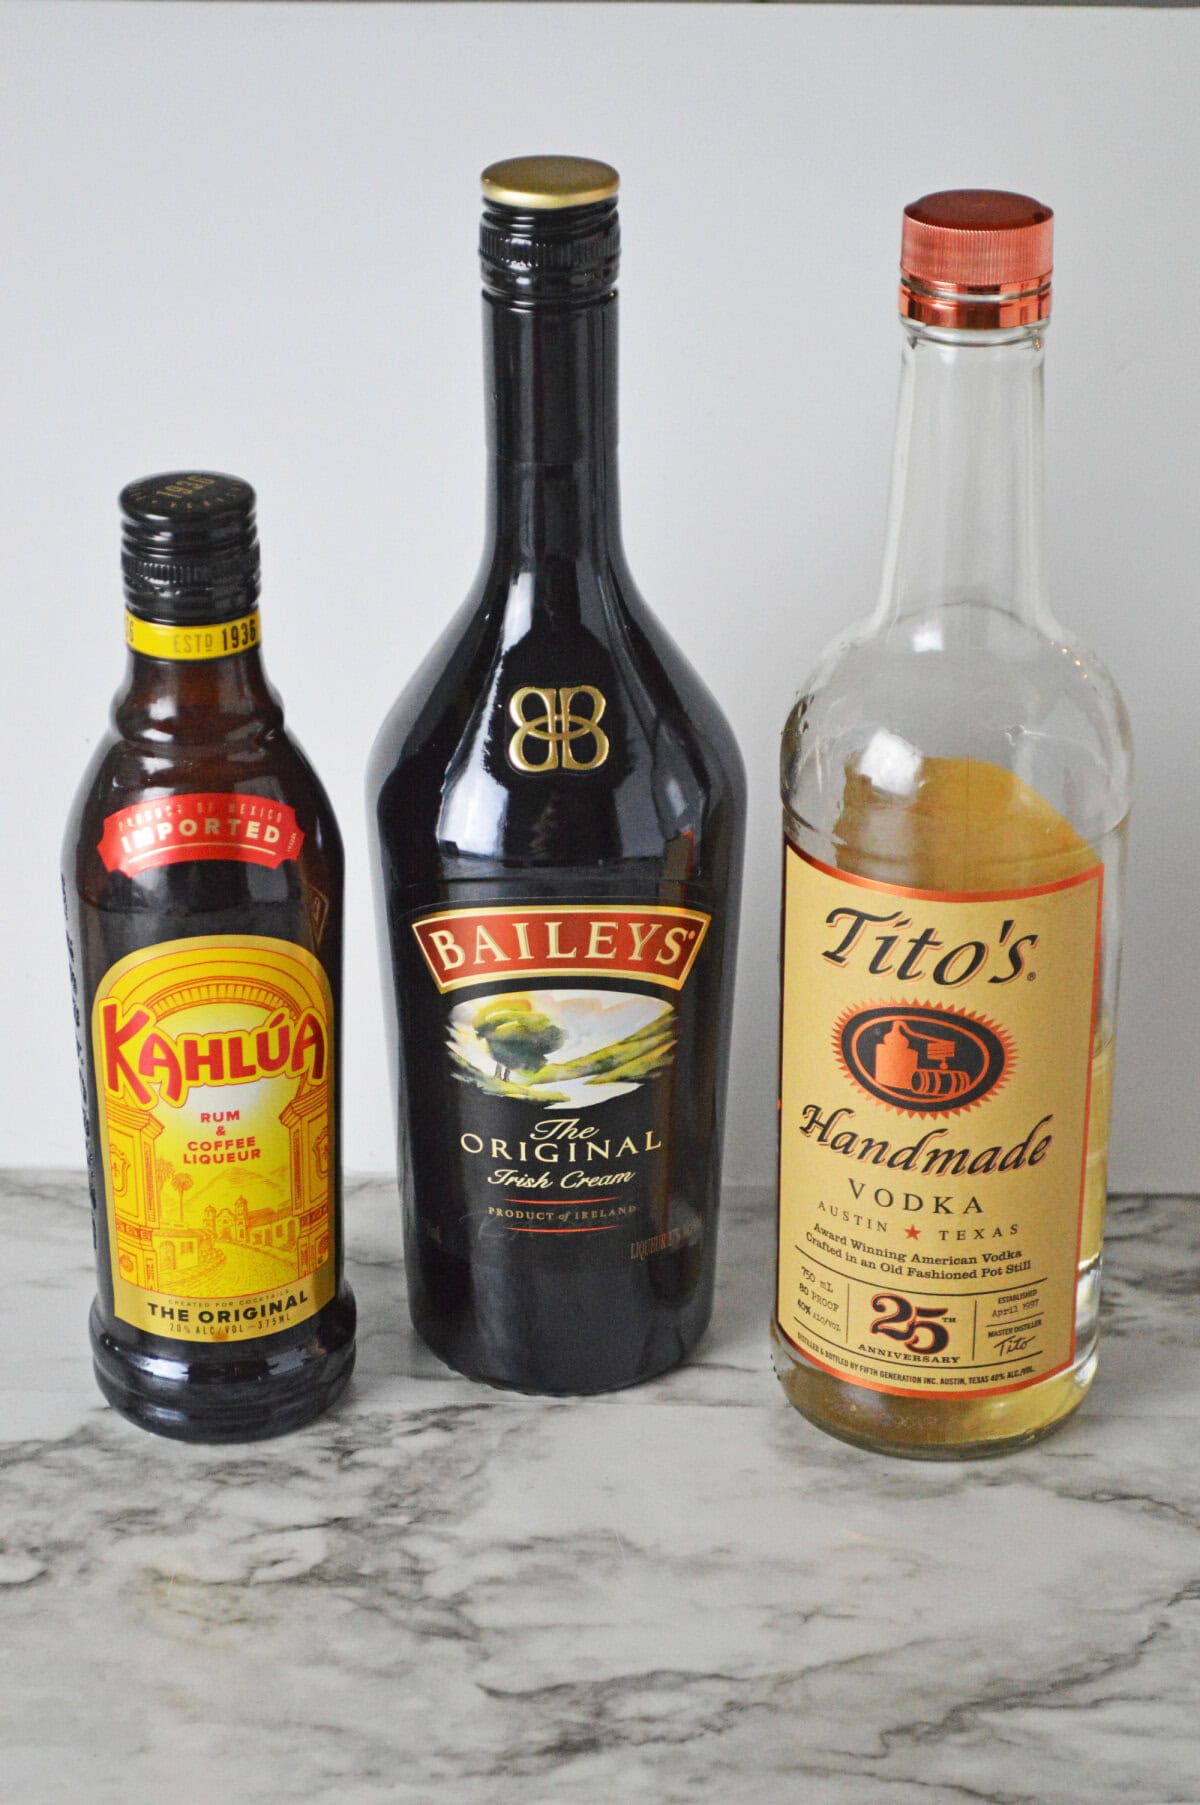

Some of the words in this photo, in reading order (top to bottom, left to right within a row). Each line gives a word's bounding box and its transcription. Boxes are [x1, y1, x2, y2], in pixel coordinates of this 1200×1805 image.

[222, 618, 257, 651] 1936
[428, 920, 688, 971] BAILEYS
[821, 907, 1039, 986] Tito's
[102, 1003, 325, 1105] KAHLÚA
[200, 1110, 240, 1123] RUM
[215, 1126, 226, 1137] &
[529, 1118, 600, 1140] The
[187, 1136, 257, 1152] COFFEE
[460, 1131, 662, 1163] ORIGINAL
[799, 1104, 1054, 1175] Handmade
[182, 1149, 262, 1165] LIQUEUR
[488, 1169, 554, 1189] Irish
[560, 1170, 637, 1189] Cream
[847, 1178, 985, 1215] VODKA
[487, 1206, 553, 1221] PRODUCT
[558, 1210, 570, 1223] of
[574, 1205, 637, 1220] IRELAND
[817, 1201, 889, 1233] AUSTIN
[938, 1224, 1019, 1242] TEXAS
[806, 1231, 843, 1259] Crafted
[846, 1251, 858, 1264] in
[860, 1257, 877, 1270] an
[880, 1262, 903, 1276] Old
[906, 1267, 978, 1281] Fashioned
[981, 1266, 1003, 1279] Pot
[1005, 1260, 1032, 1274] Still
[814, 1222, 847, 1247] Award
[850, 1238, 908, 1264] Winning
[911, 1252, 978, 1266] American
[981, 1250, 1023, 1263] Vodka
[147, 1302, 190, 1323] THE
[197, 1290, 309, 1324] ORIGINAL
[811, 1290, 840, 1313] PROOF
[992, 1305, 1019, 1318] April
[988, 1327, 1013, 1338] MASTER
[825, 1349, 849, 1367] BOTTLED
[850, 1361, 860, 1371] BY
[859, 1364, 879, 1377] FIFTH
[879, 1370, 922, 1384] GENERATION
[923, 1377, 939, 1385] INC.
[968, 1375, 990, 1385] TEXAS
[857, 1343, 961, 1364] ANNIVERSARY
